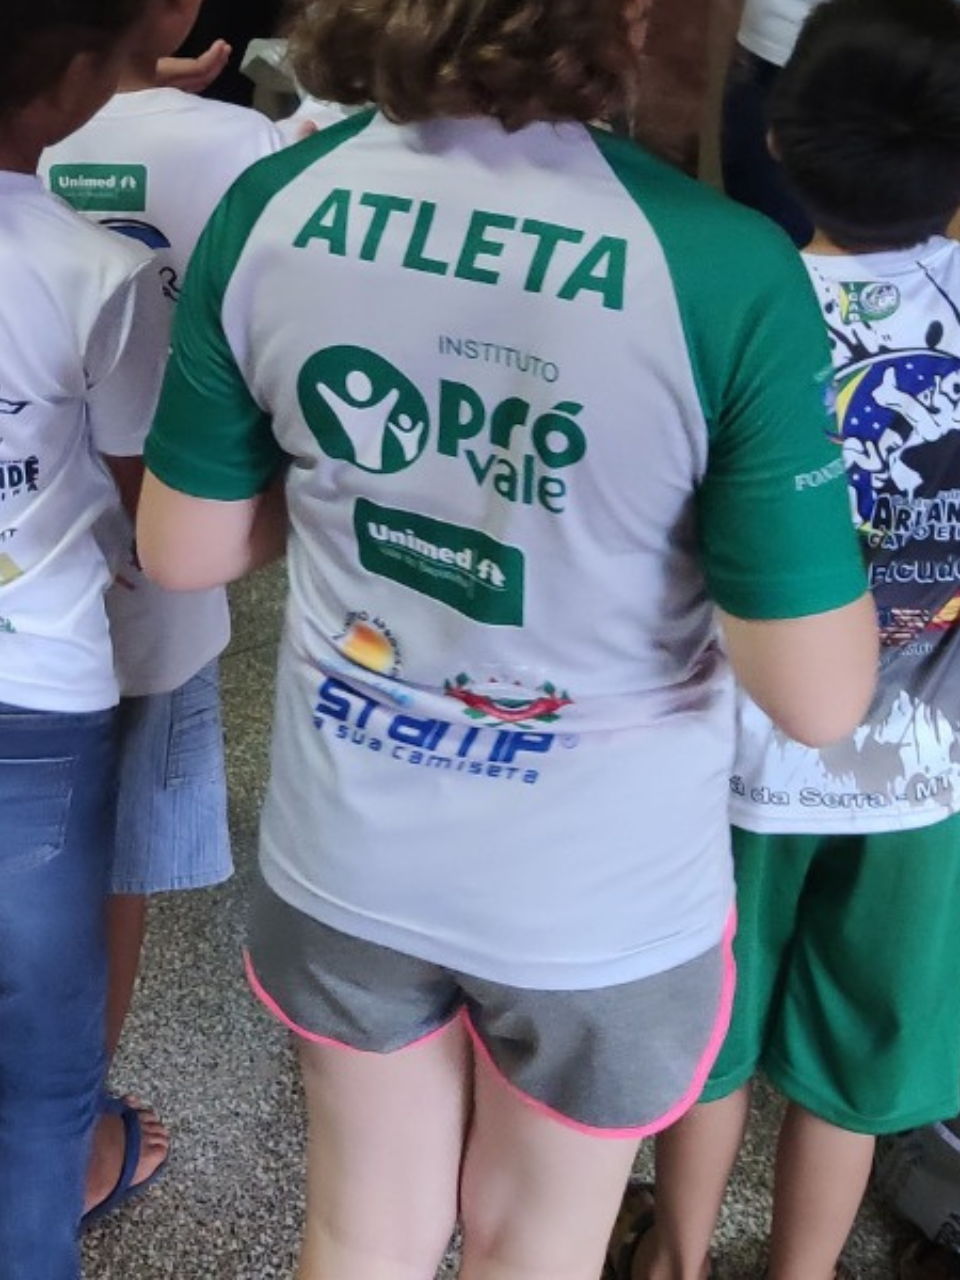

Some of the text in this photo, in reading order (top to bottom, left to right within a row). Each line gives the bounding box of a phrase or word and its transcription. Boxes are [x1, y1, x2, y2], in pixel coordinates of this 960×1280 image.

[58, 175, 116, 189] Unimed
[292, 187, 628, 312] ATLETA
[438, 335, 560, 383] INSTITUTO
[464, 448, 567, 515] vale
[367, 521, 472, 570] Unimed
[751, 786, 790, 805] da
[799, 786, 888, 809] Serra
